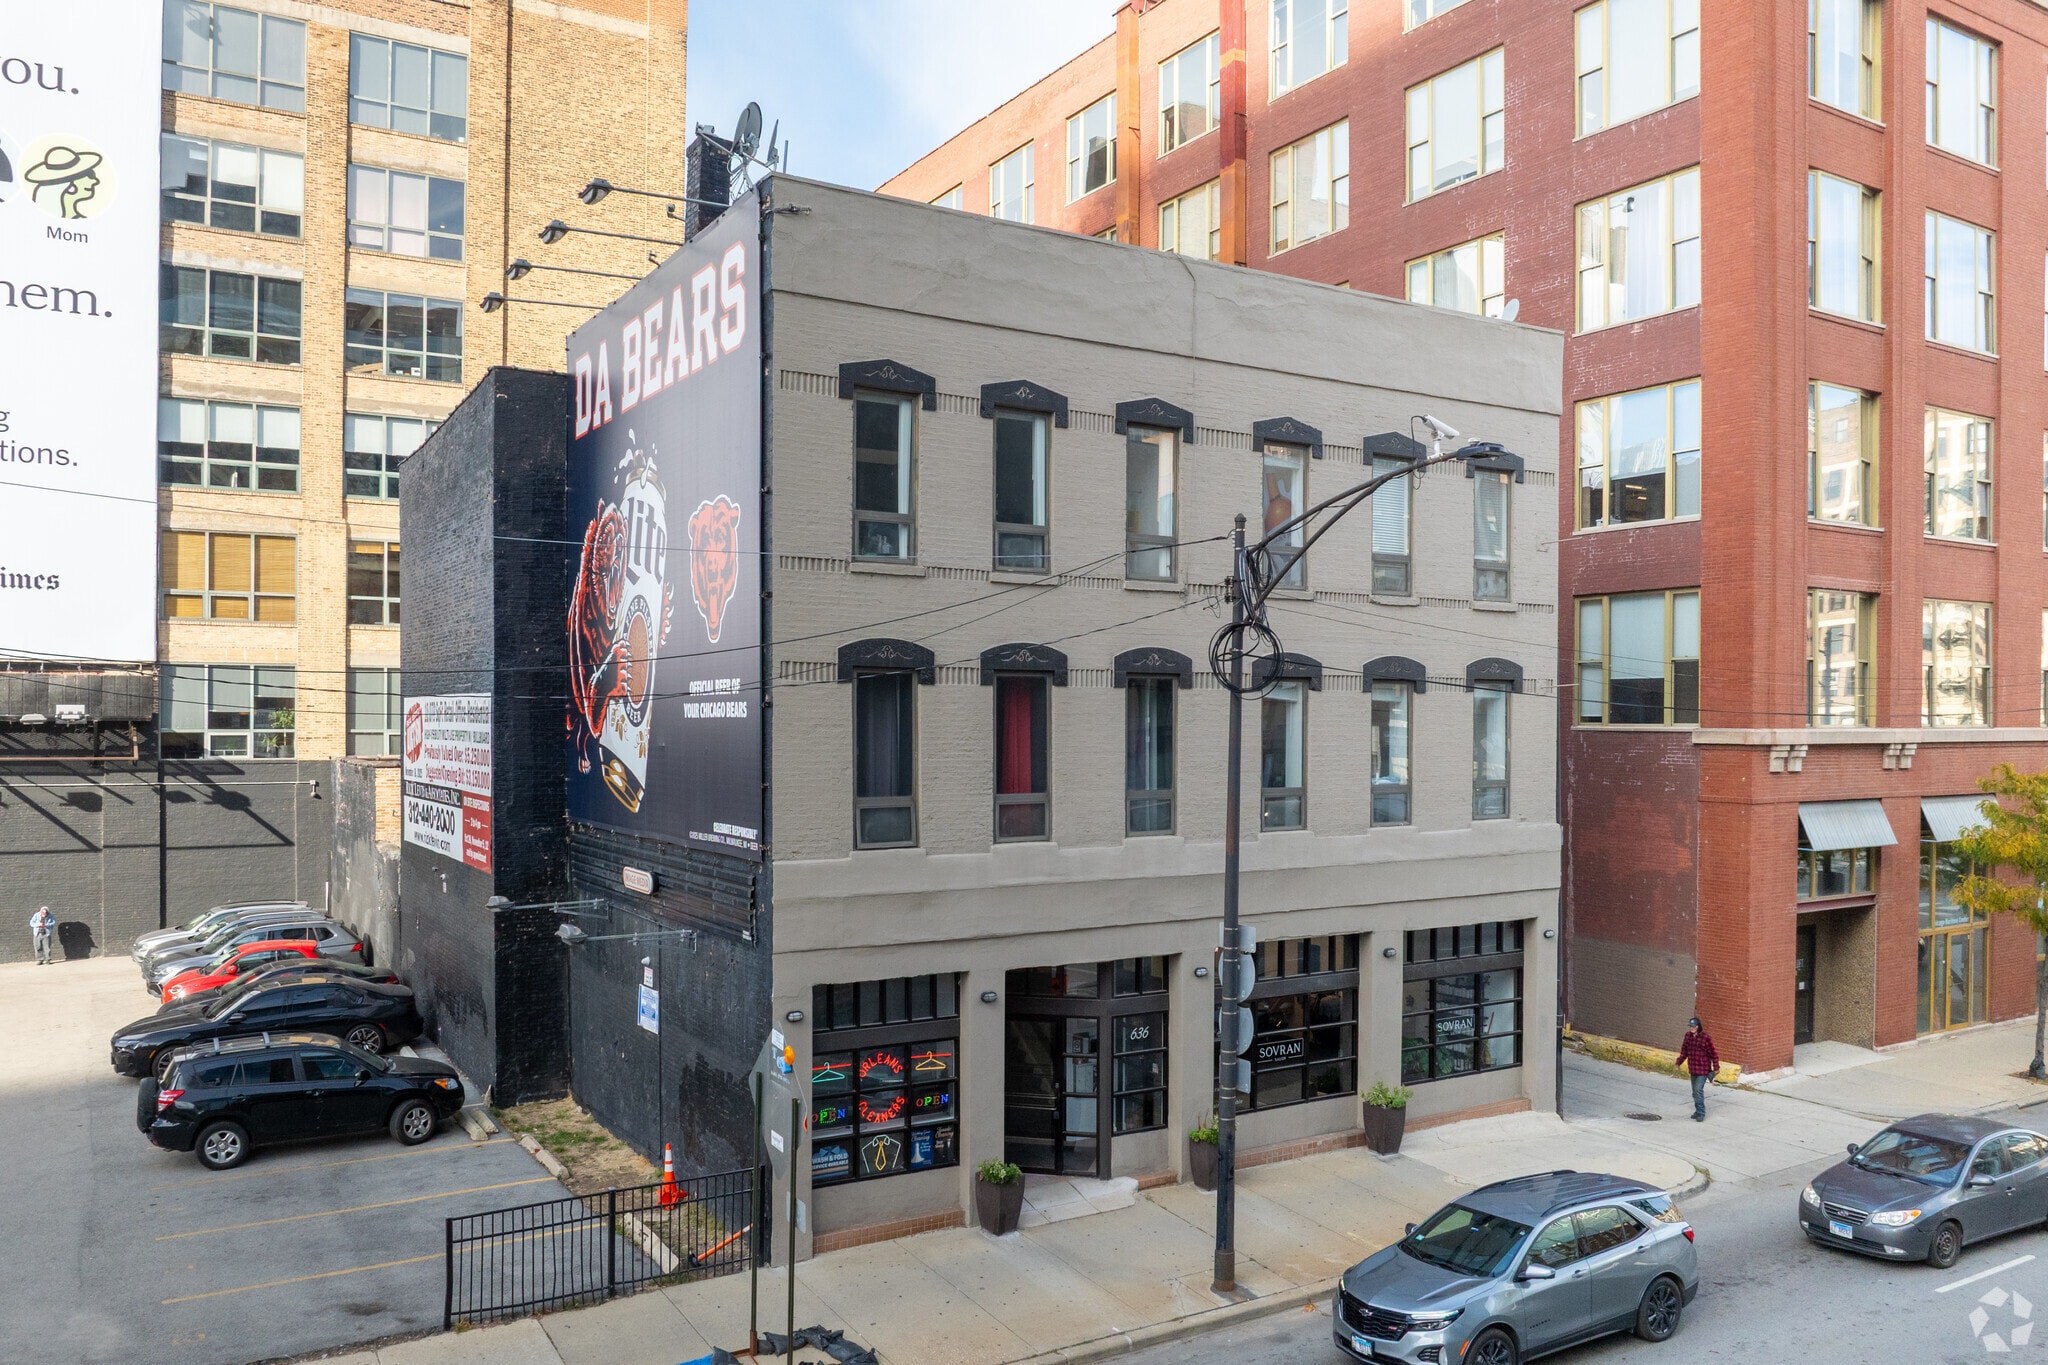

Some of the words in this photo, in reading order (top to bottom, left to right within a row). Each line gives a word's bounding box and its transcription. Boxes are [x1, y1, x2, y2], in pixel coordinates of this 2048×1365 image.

[0, 56, 80, 95] ou.
[46, 225, 89, 244] Mom
[575, 339, 613, 440] DA
[621, 240, 746, 415] BEARS
[625, 496, 667, 586] Lite
[625, 598, 640, 627] FINE
[689, 679, 715, 697] OFFICIAL
[714, 678, 731, 695] BEER
[732, 678, 741, 694] OF
[626, 702, 642, 724] BEER
[684, 702, 700, 718] YOUR
[700, 702, 726, 718] CHICAGO
[726, 701, 748, 718] BEARS
[408, 800, 455, 836] 312-440-2000
[1130, 1026, 1150, 1040] 636
[1437, 1018, 1473, 1032] SOVRAN
[1259, 1042, 1302, 1059] SOVRAN
[858, 1051, 903, 1078] ORLEANS
[858, 1096, 906, 1124] CLEANERS
[915, 1093, 949, 1108] OPEN
[812, 1108, 846, 1123] OPEN
[834, 1152, 849, 1160] FOLD
